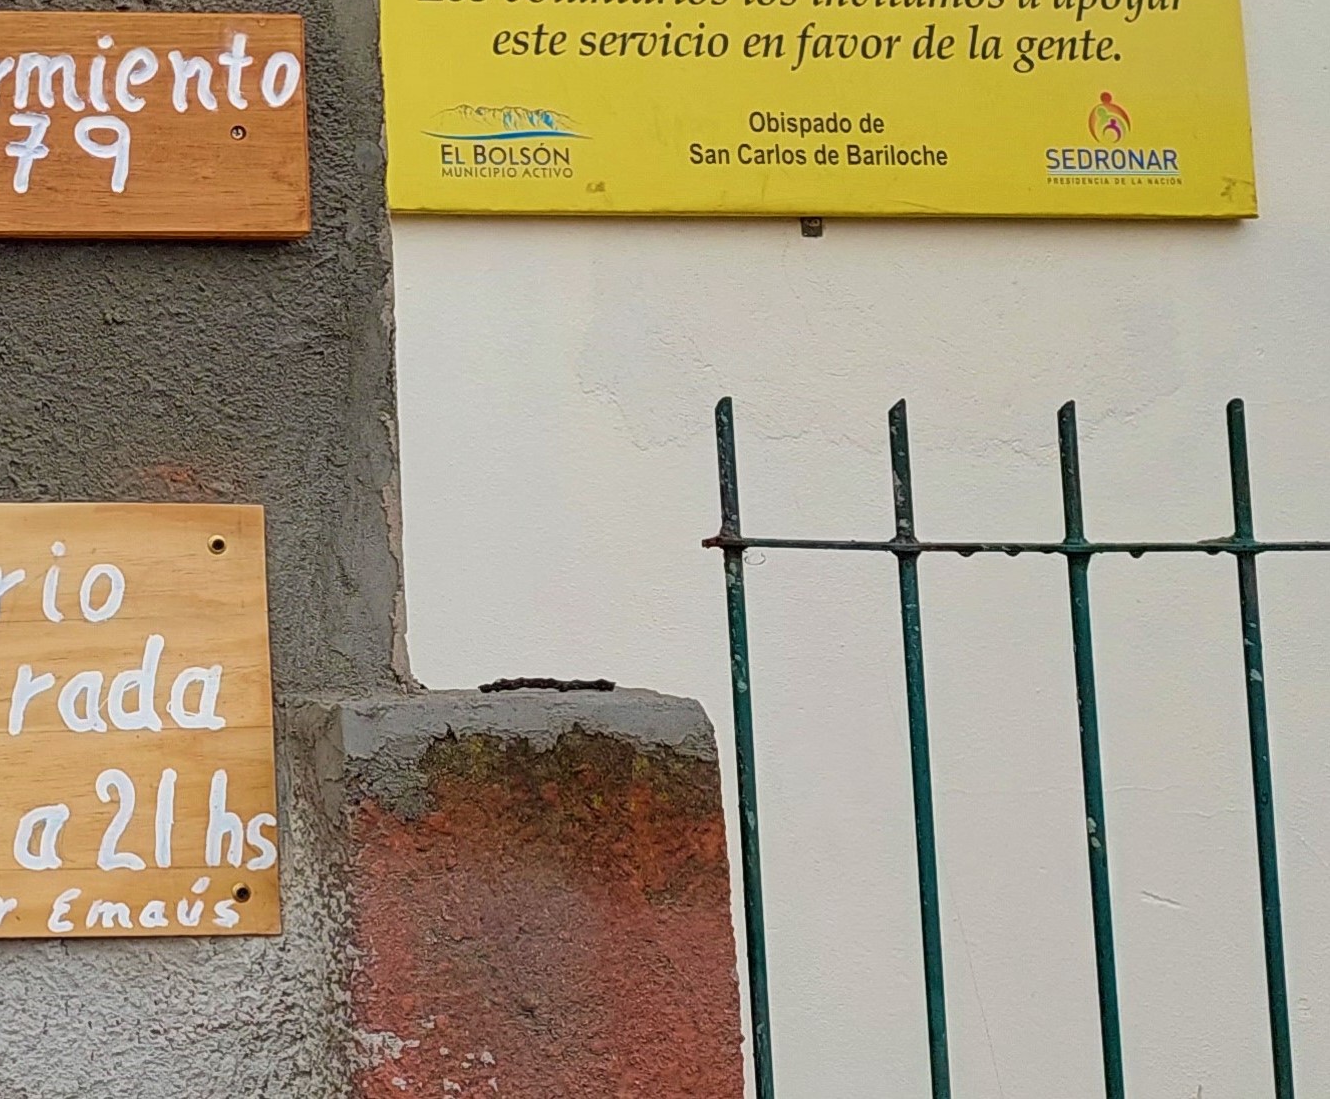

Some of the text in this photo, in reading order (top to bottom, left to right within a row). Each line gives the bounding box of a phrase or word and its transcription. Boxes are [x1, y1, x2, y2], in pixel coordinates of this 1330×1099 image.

[493, 22, 1121, 73] este servicio en favor de la gente.
[749, 112, 884, 138] Obispado de
[441, 143, 569, 165] EL BOLSÓN
[690, 144, 948, 165] San Carlos de Bariloche
[1046, 149, 1178, 170] SEDRONAR
[442, 168, 573, 178] MUNICIPIO ACTIVO
[13, 803, 70, 871] a
[205, 768, 277, 871] hs
[48, 876, 240, 933] Emaús
